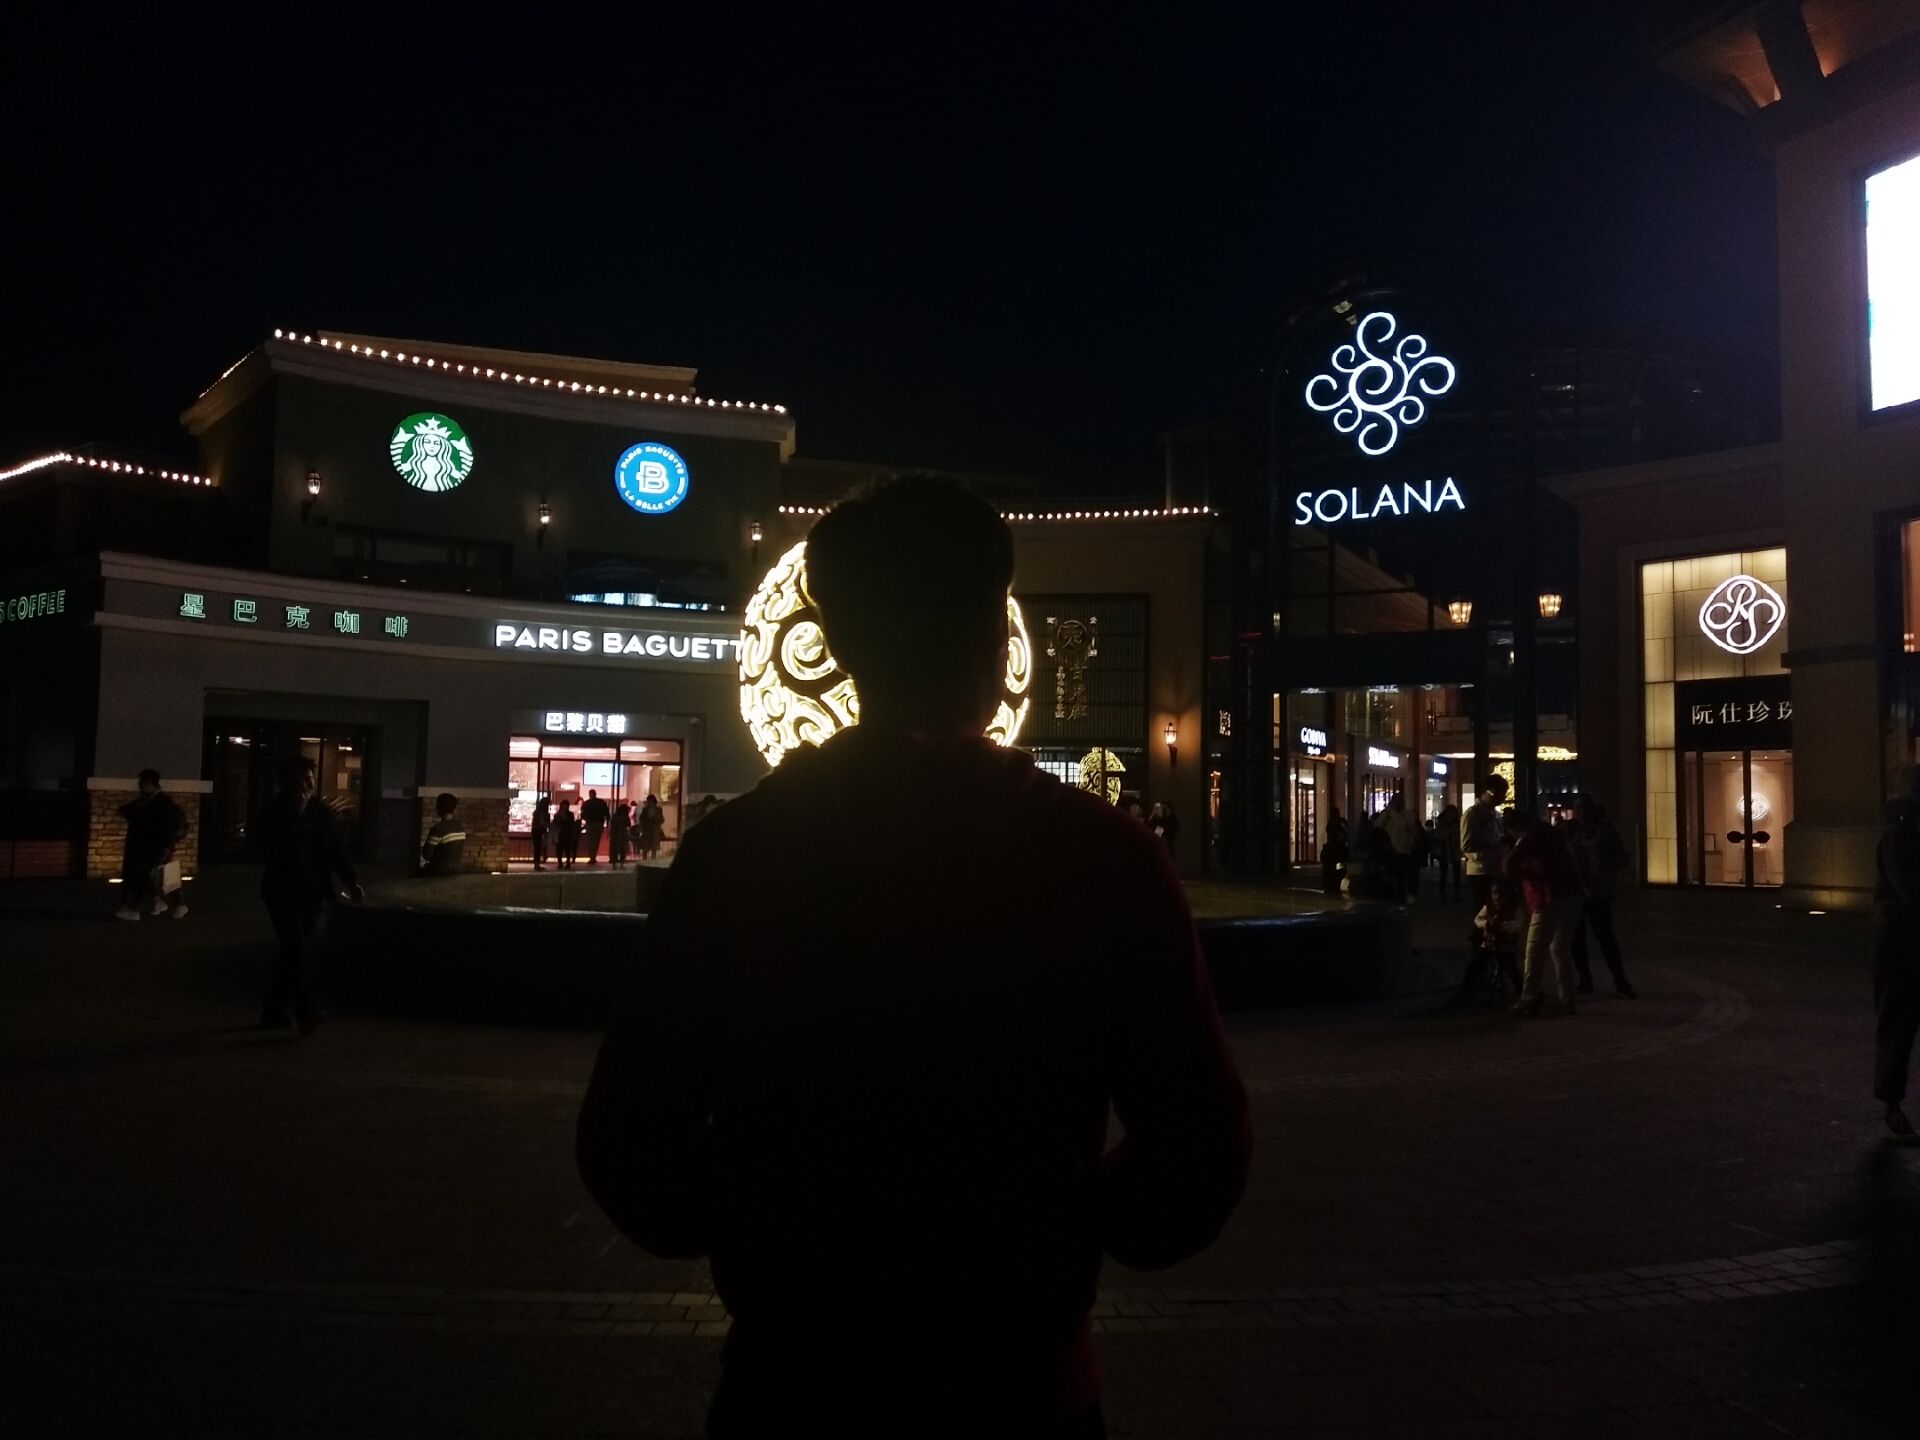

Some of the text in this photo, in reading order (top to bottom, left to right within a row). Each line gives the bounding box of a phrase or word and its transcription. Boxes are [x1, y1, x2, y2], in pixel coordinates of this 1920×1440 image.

[1295, 476, 1465, 525] SOLANA
[7, 589, 66, 621] COFFEE
[179, 592, 409, 638] 星巴克咖啡
[495, 624, 745, 662] PARIS BAGUETT
[545, 711, 626, 735] 巴黎贝甜
